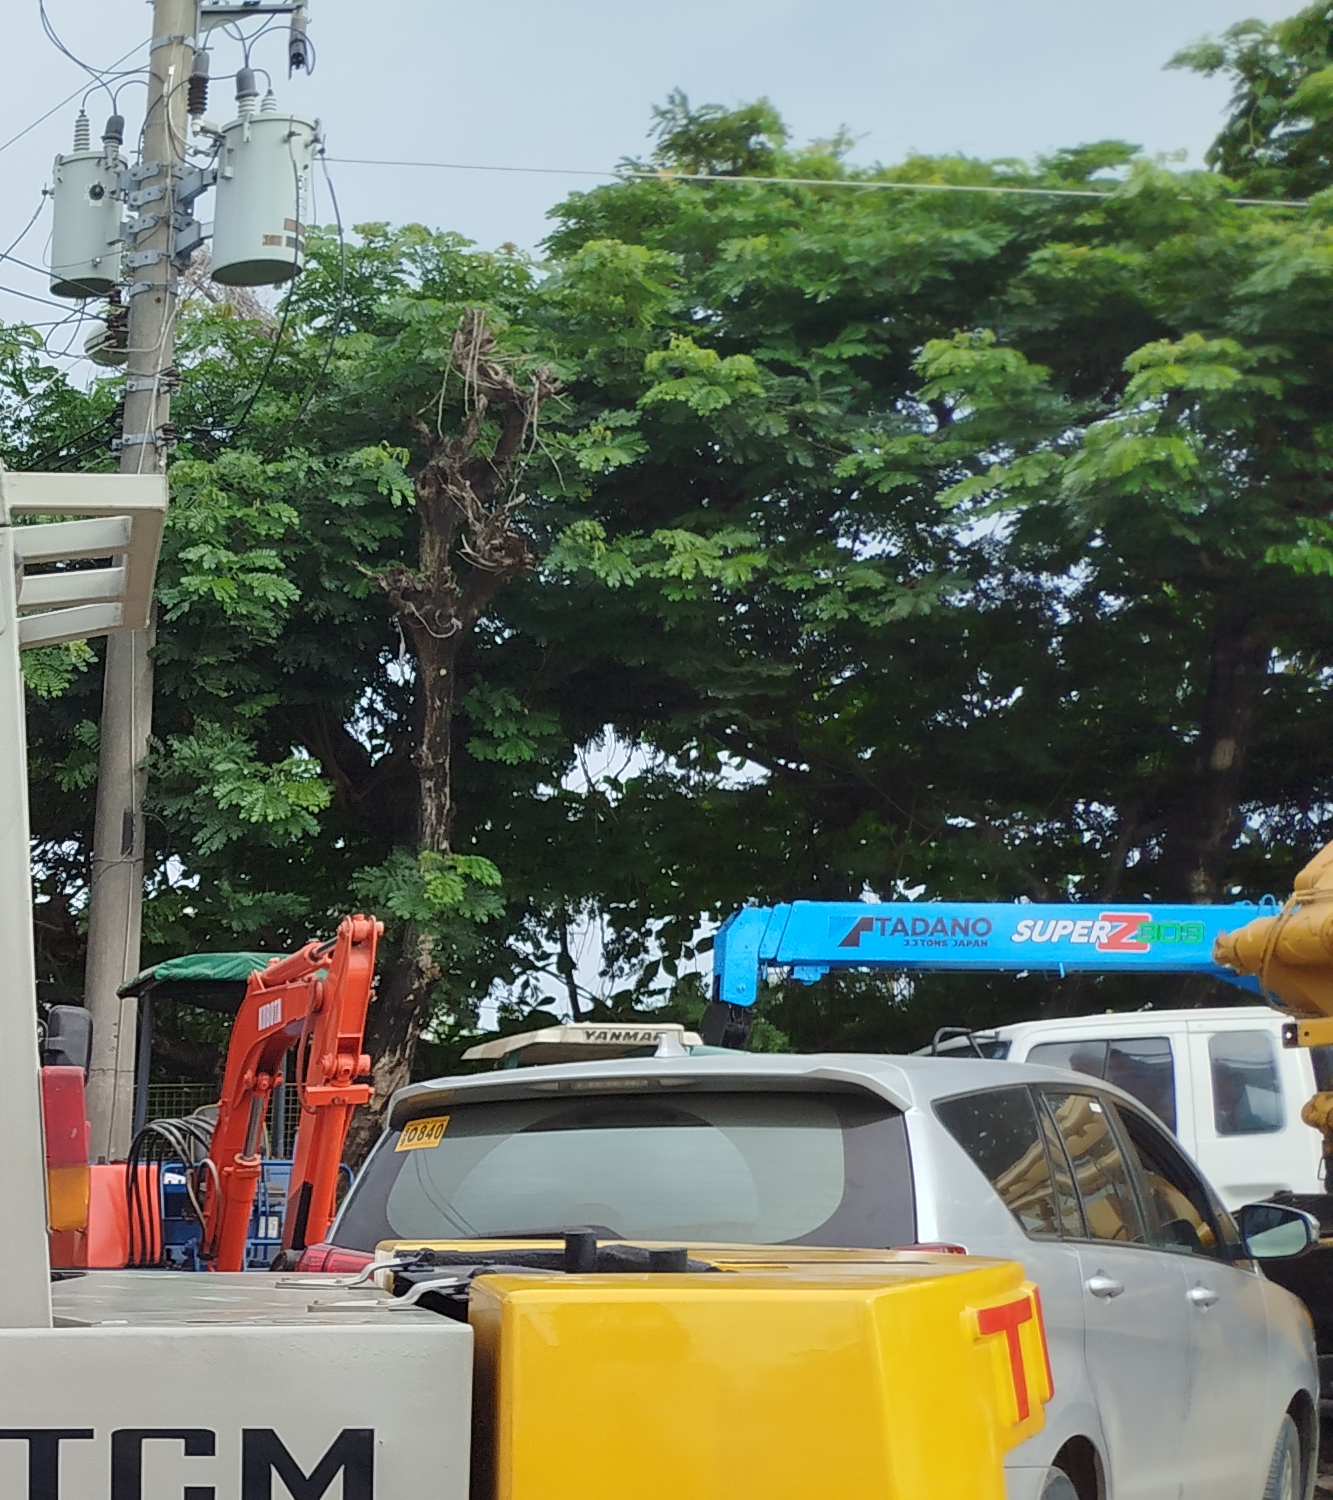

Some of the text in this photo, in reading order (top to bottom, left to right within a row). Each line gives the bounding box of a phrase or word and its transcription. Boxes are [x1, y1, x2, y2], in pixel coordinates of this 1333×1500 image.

[875, 917, 992, 937] TADANO
[952, 939, 988, 947] JAPAN
[407, 1122, 444, 1142] 0840
